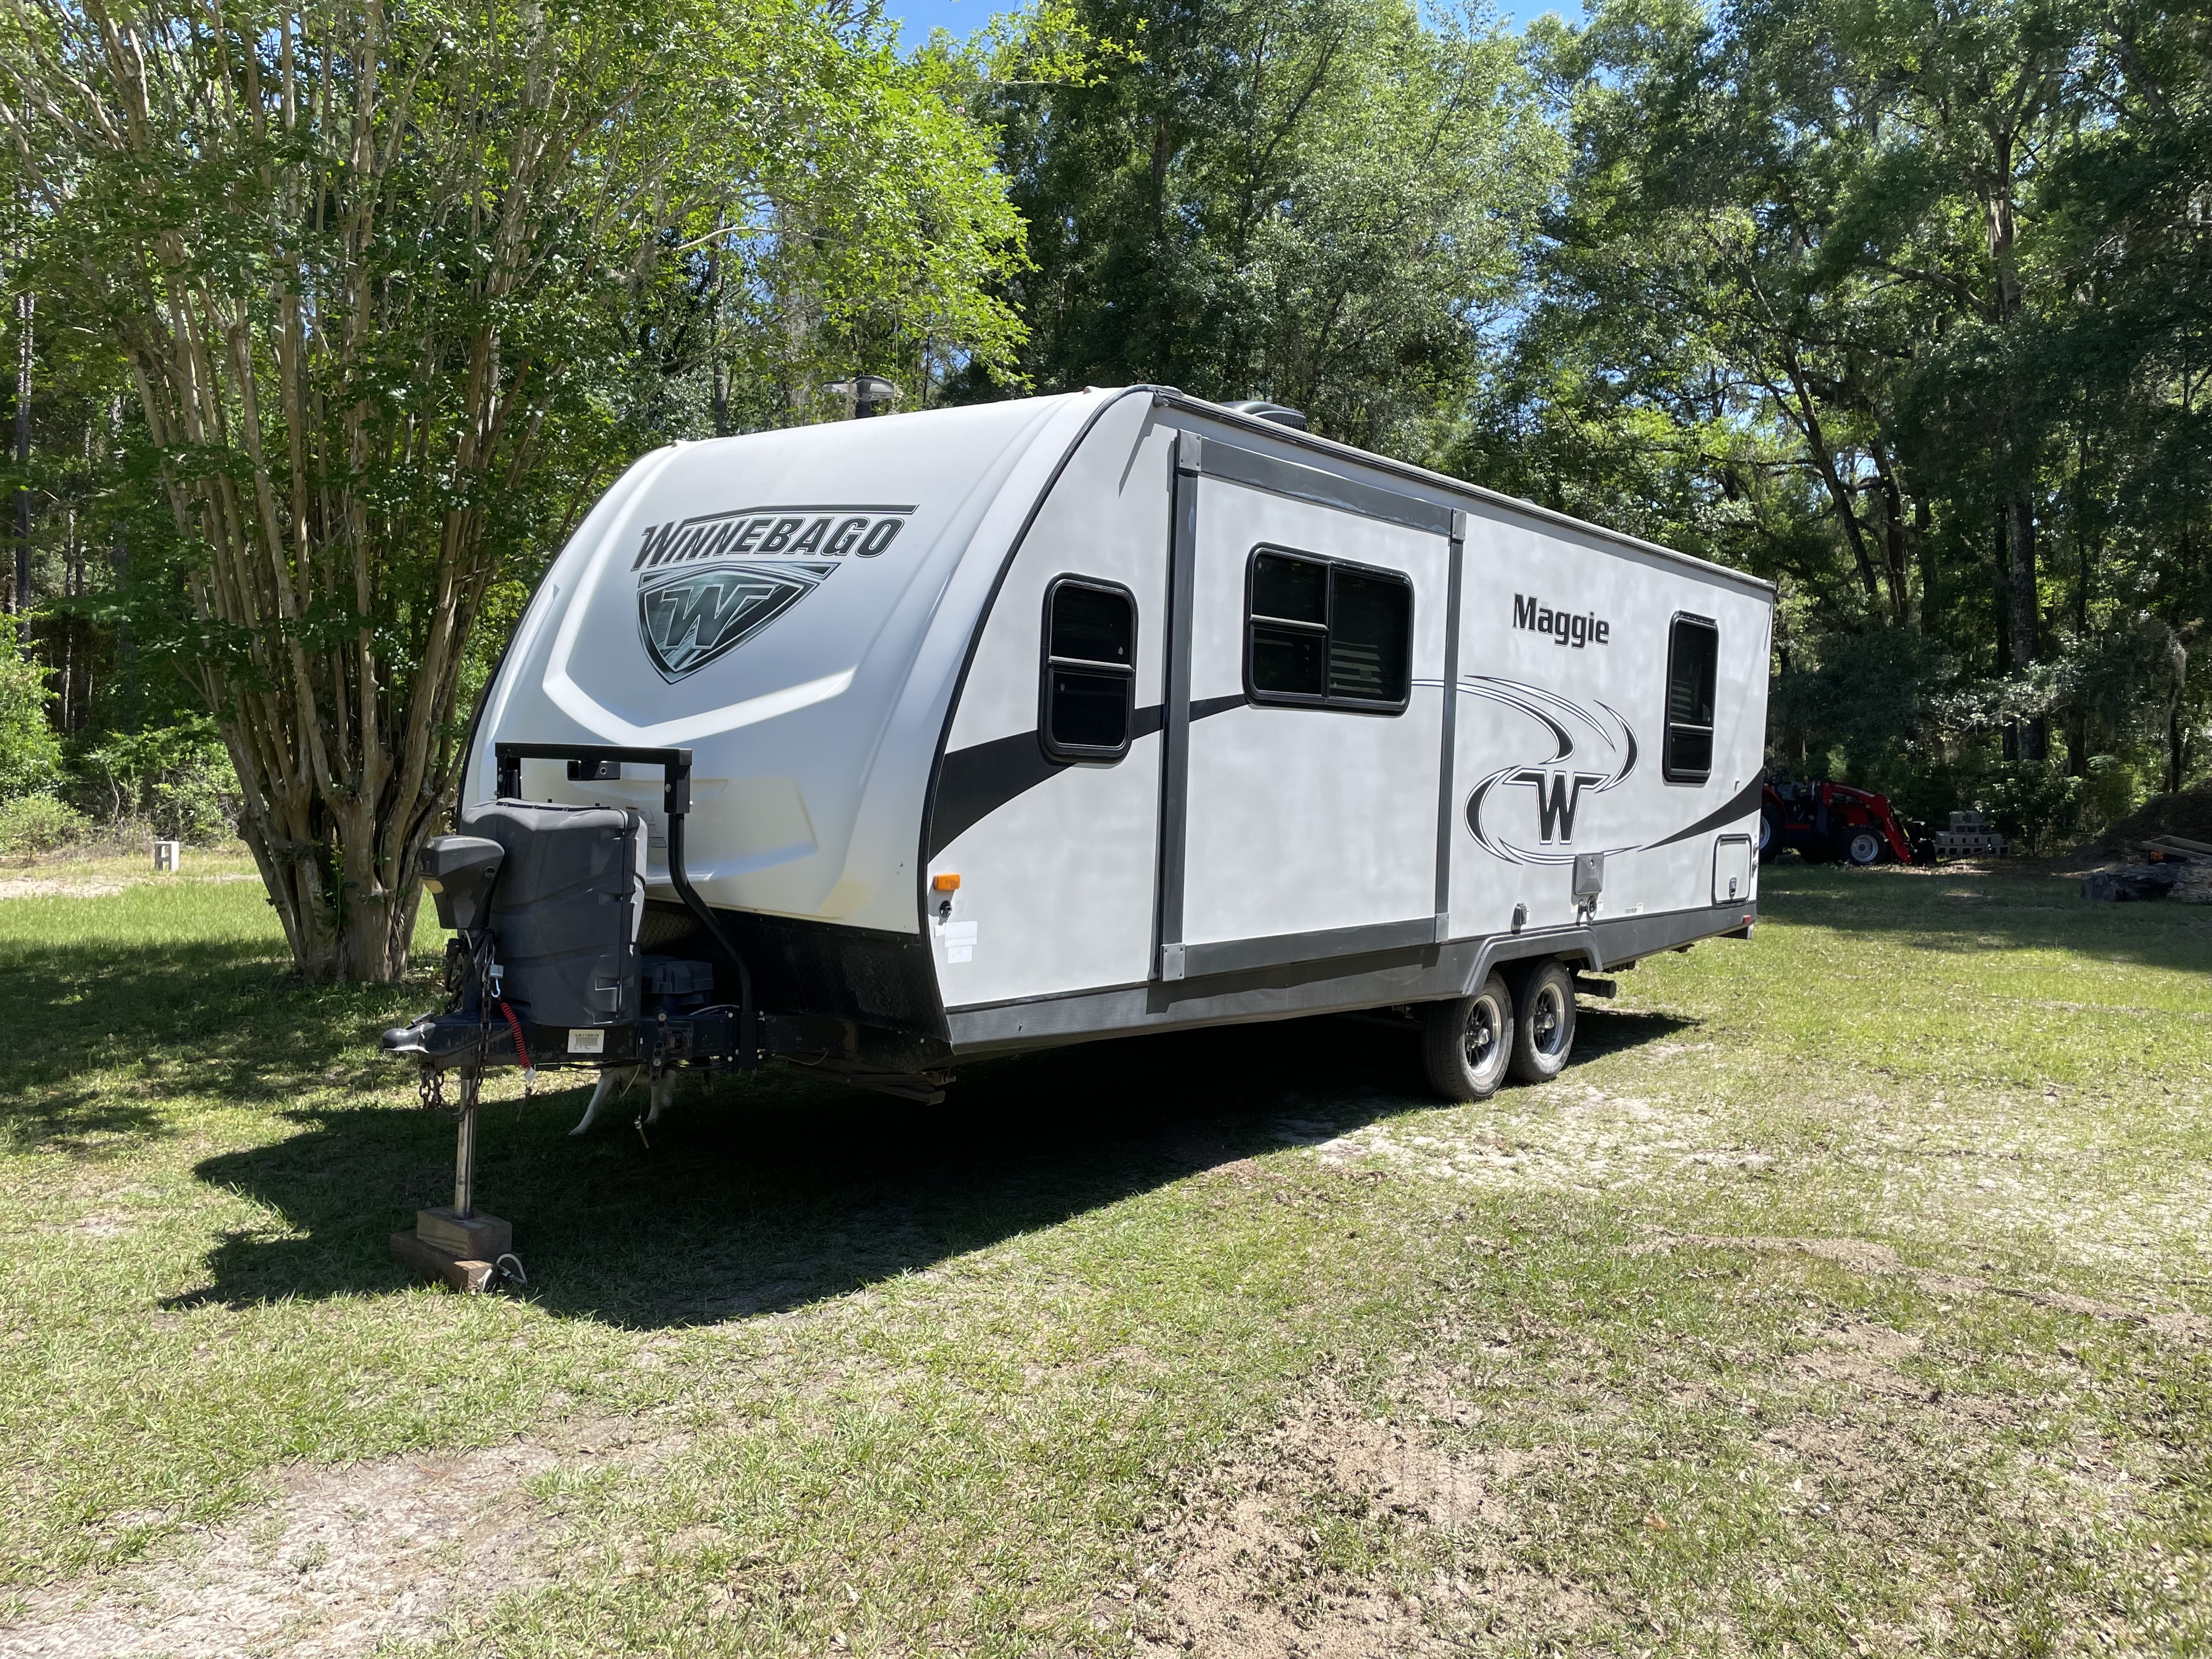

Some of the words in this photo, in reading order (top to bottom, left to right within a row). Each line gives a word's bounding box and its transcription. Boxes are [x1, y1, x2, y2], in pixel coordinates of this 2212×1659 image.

[630, 517, 905, 572] WINNEBAGO
[659, 584, 777, 650] W
[1512, 592, 1610, 650] Maggie
[1502, 768, 1610, 845] W
